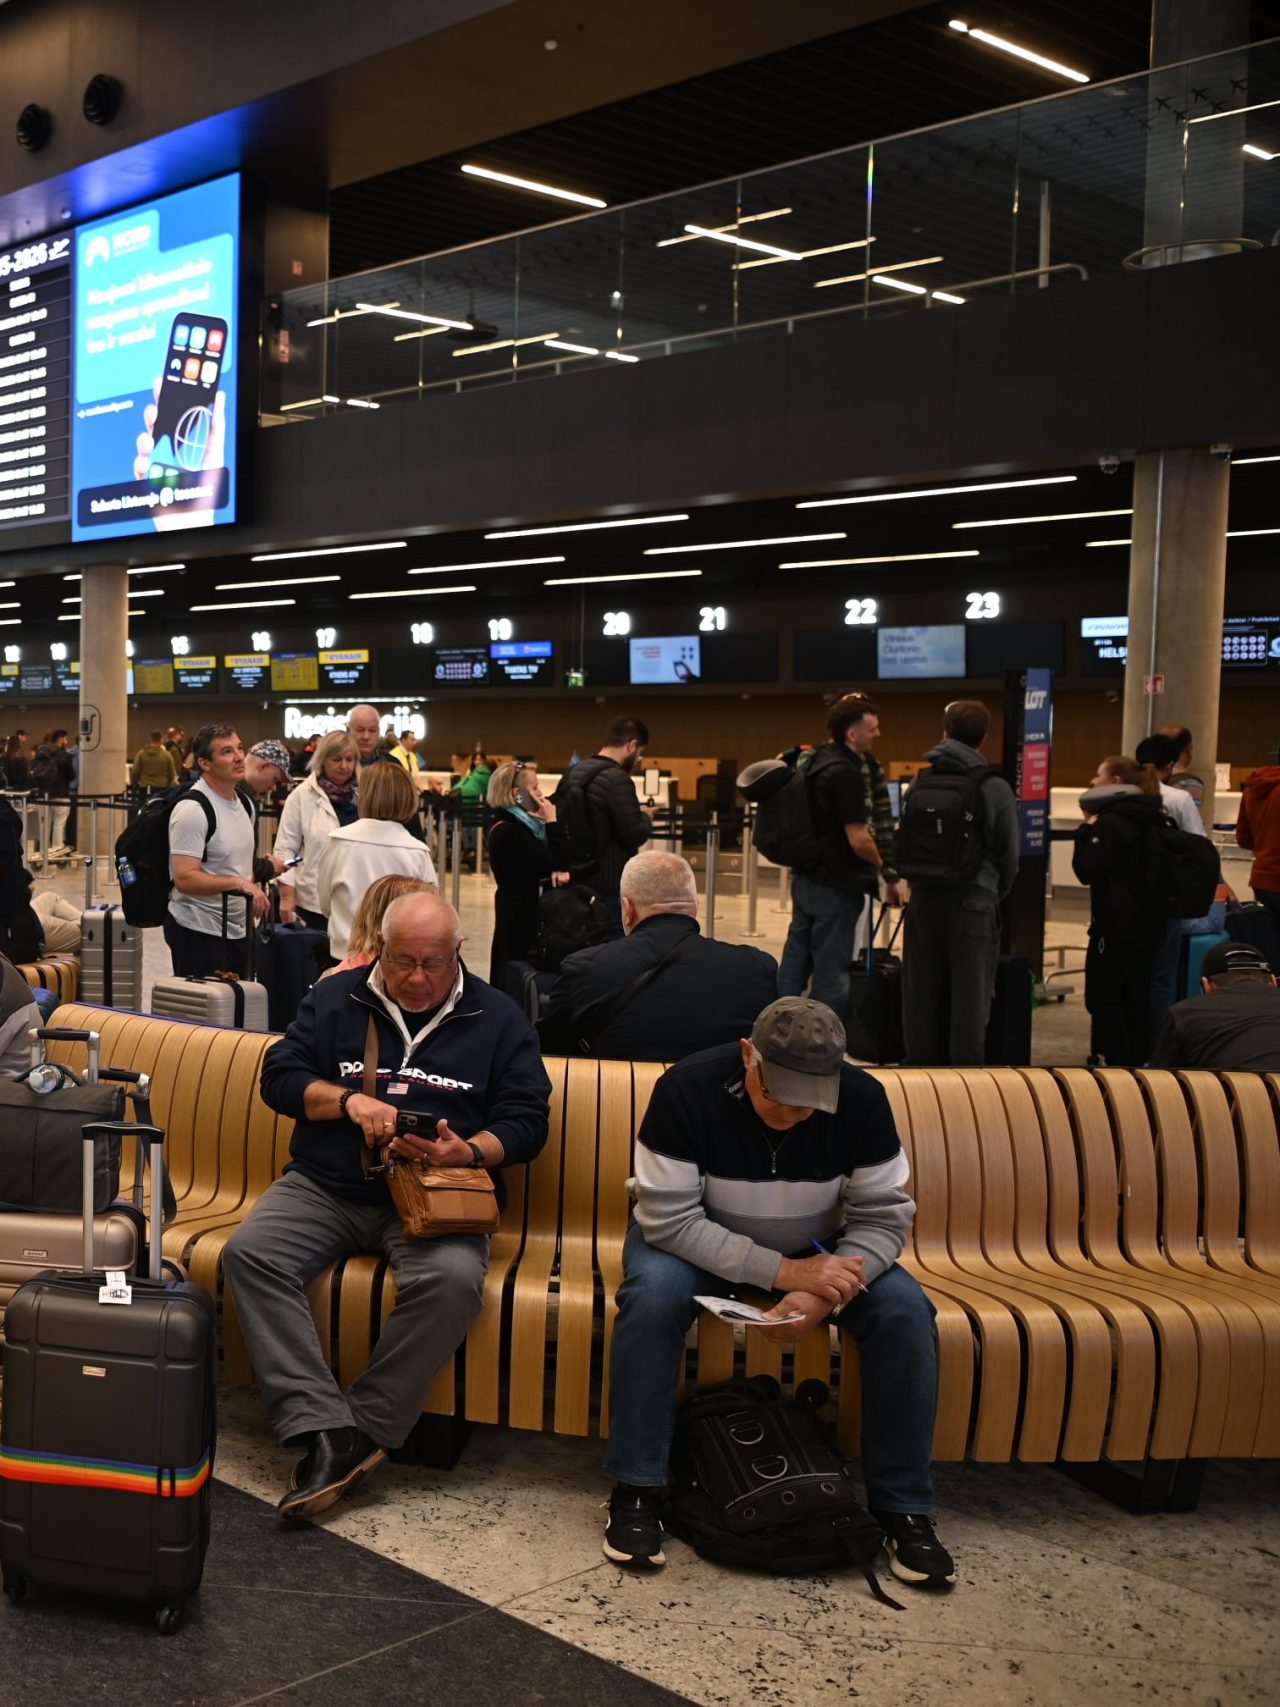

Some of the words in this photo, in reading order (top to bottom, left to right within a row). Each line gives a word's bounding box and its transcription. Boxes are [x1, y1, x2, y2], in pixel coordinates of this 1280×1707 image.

[845, 598, 877, 624] 22
[965, 592, 1000, 619] 23
[488, 618, 512, 640] 19
[699, 606, 726, 631] 21
[316, 628, 336, 648] 17
[411, 622, 433, 644] 18
[1024, 690, 1047, 710] LOT
[284, 706, 426, 738] Regiscija
[397, 1067, 473, 1091] SPORT
